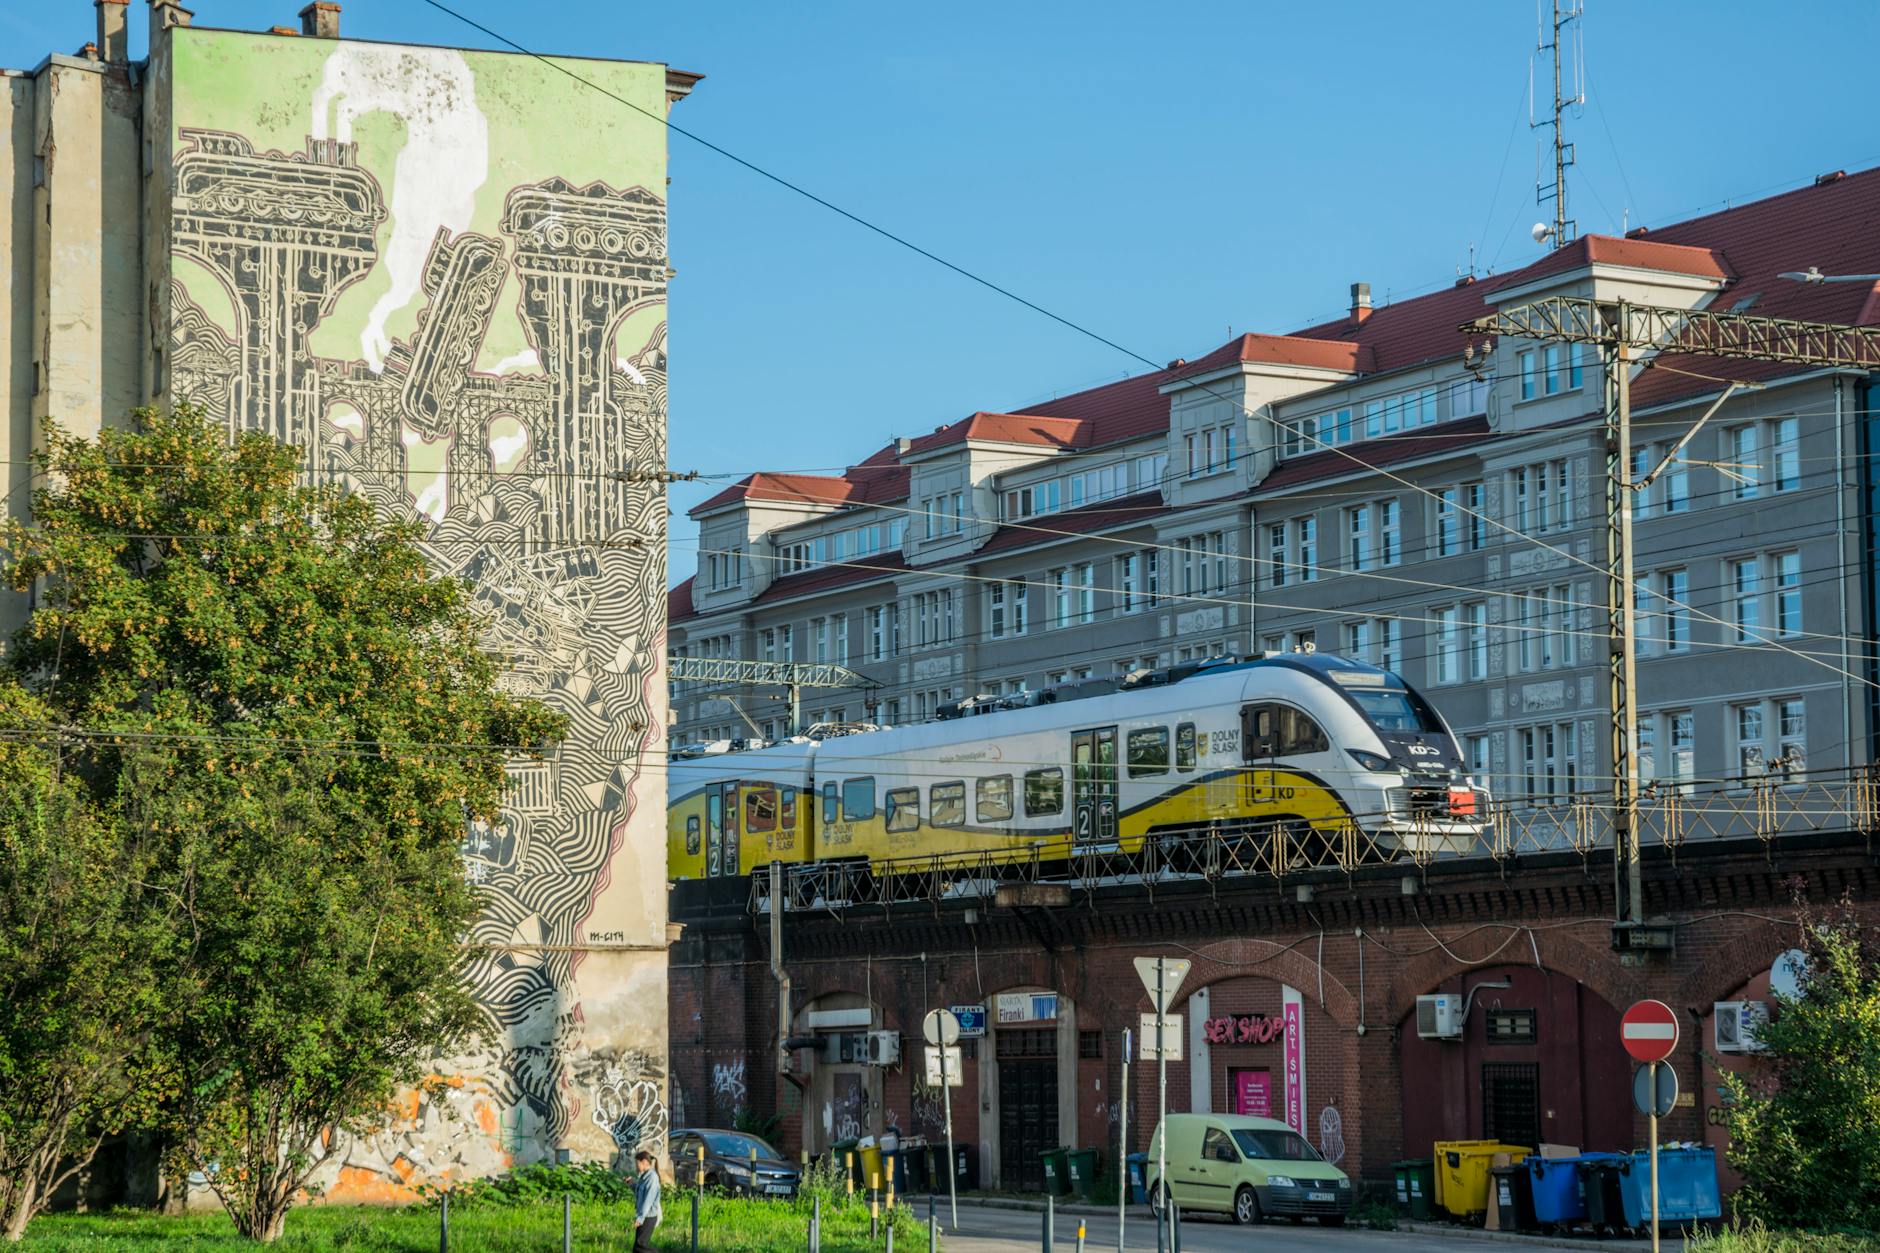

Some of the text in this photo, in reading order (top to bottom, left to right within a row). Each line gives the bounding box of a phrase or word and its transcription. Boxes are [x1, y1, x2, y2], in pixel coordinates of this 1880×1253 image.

[1212, 729, 1240, 742] DOLNY
[1407, 745, 1427, 755] KD
[1278, 787, 1295, 799] KD
[1079, 810, 1089, 835] 2
[711, 851, 718, 873] 2
[1203, 1016, 1286, 1044] SEX SHOP
